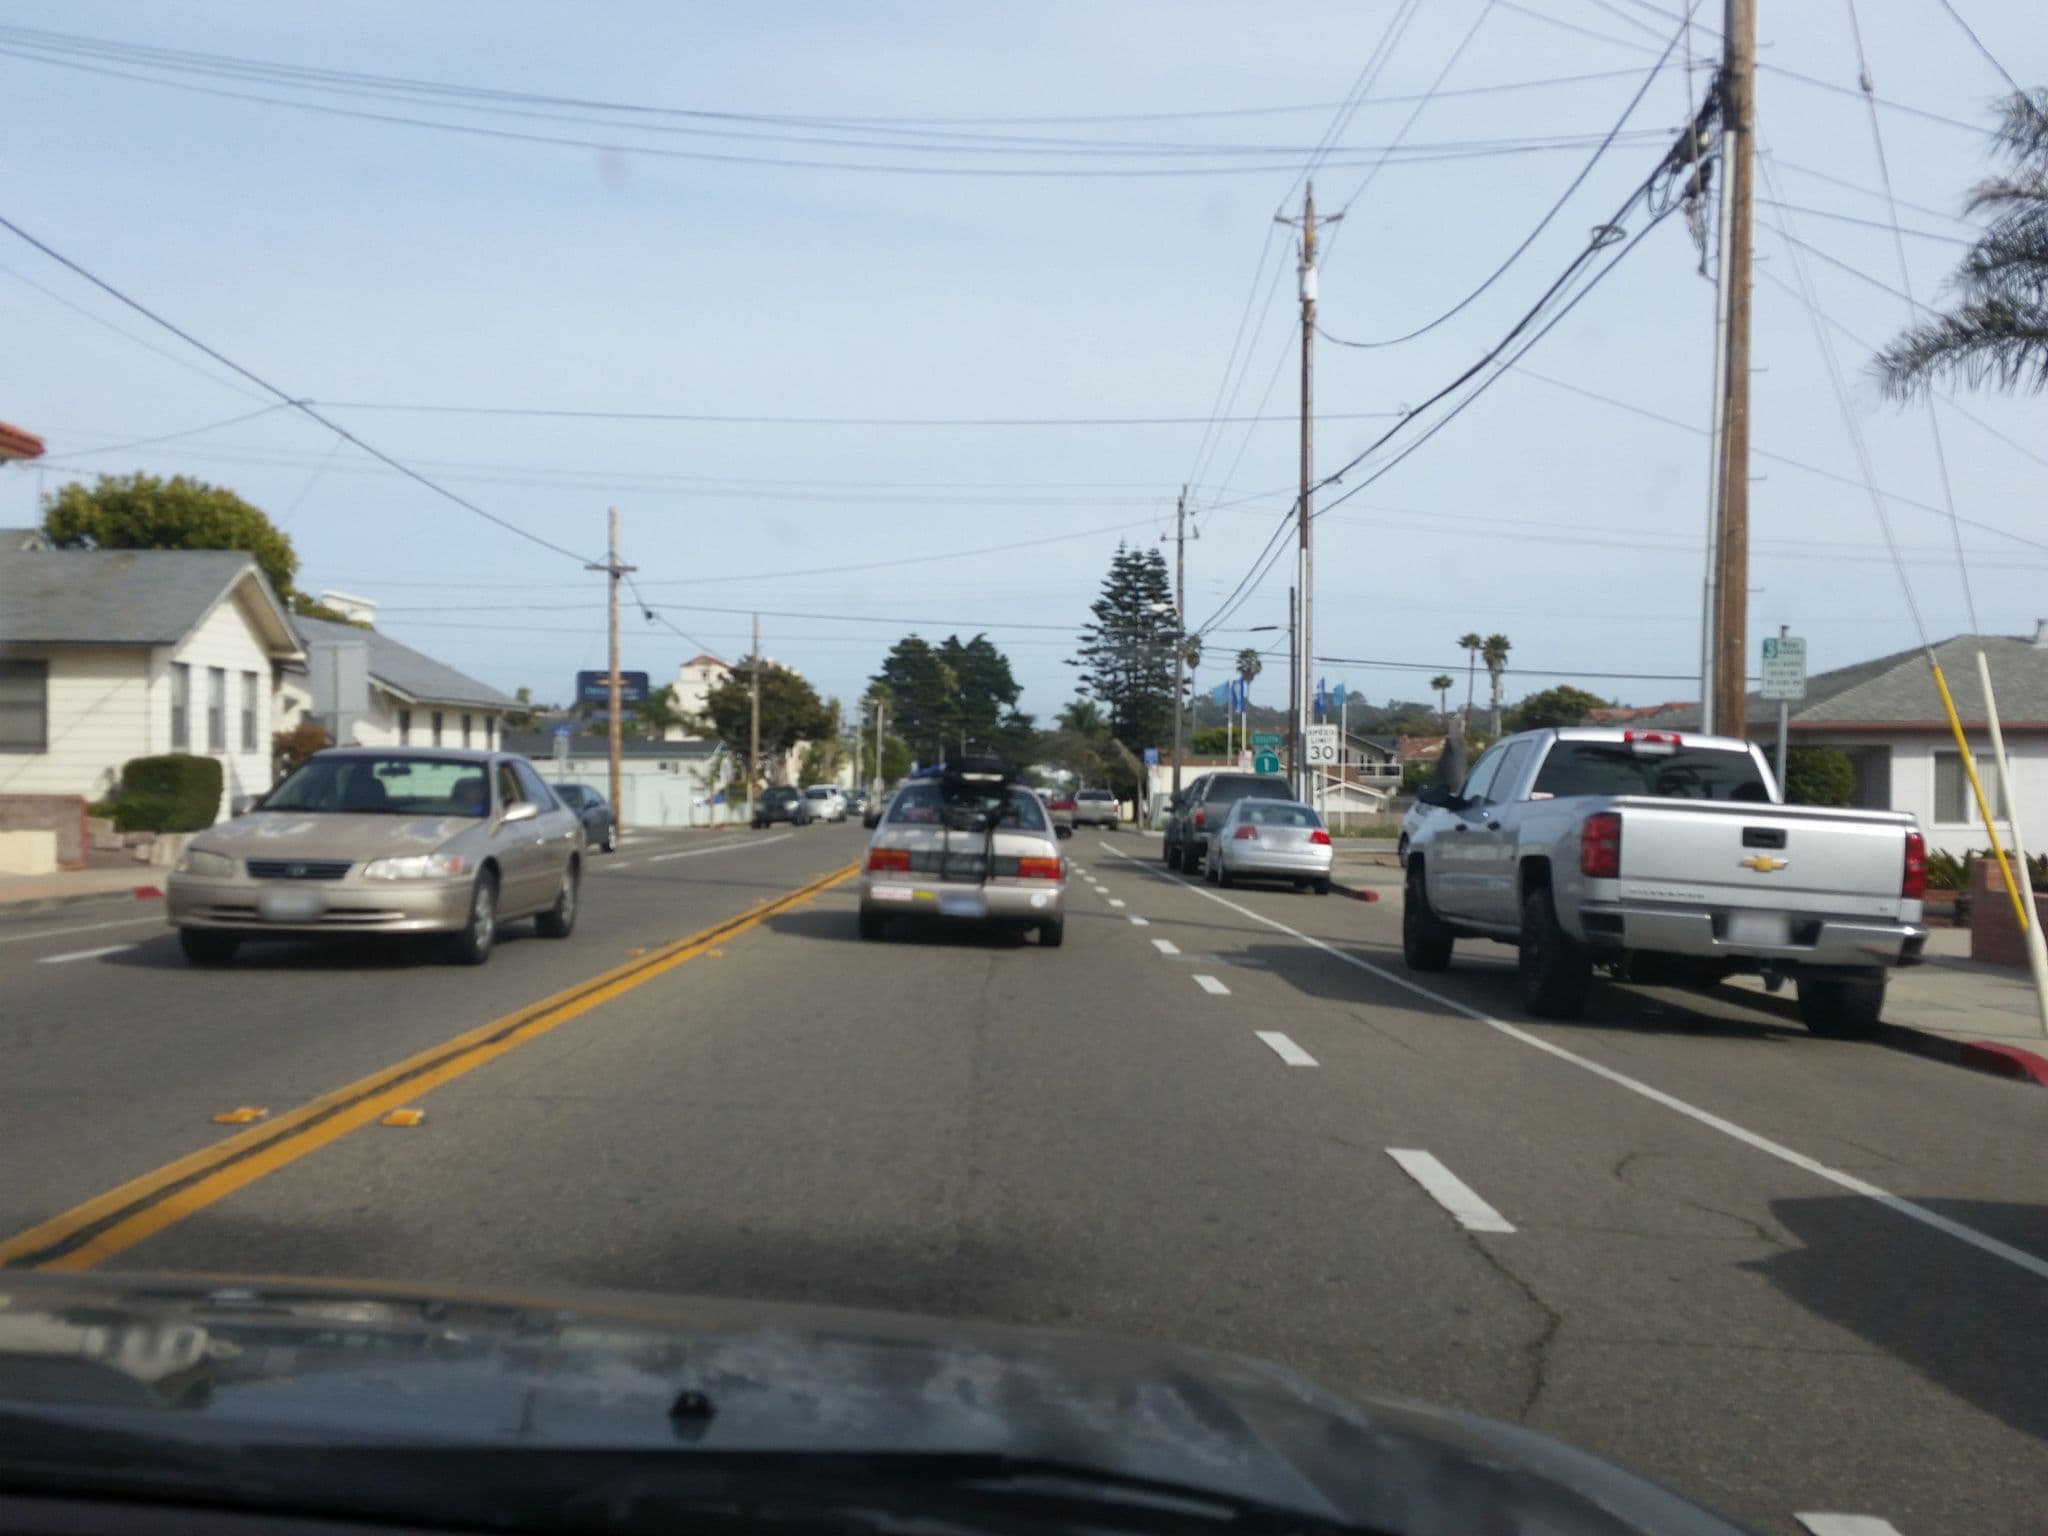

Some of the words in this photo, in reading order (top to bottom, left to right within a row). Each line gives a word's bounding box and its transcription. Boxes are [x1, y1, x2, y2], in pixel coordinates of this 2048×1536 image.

[1308, 729, 1335, 737] SPEED
[1310, 745, 1334, 760] 30
[1263, 757, 1270, 772] 1
